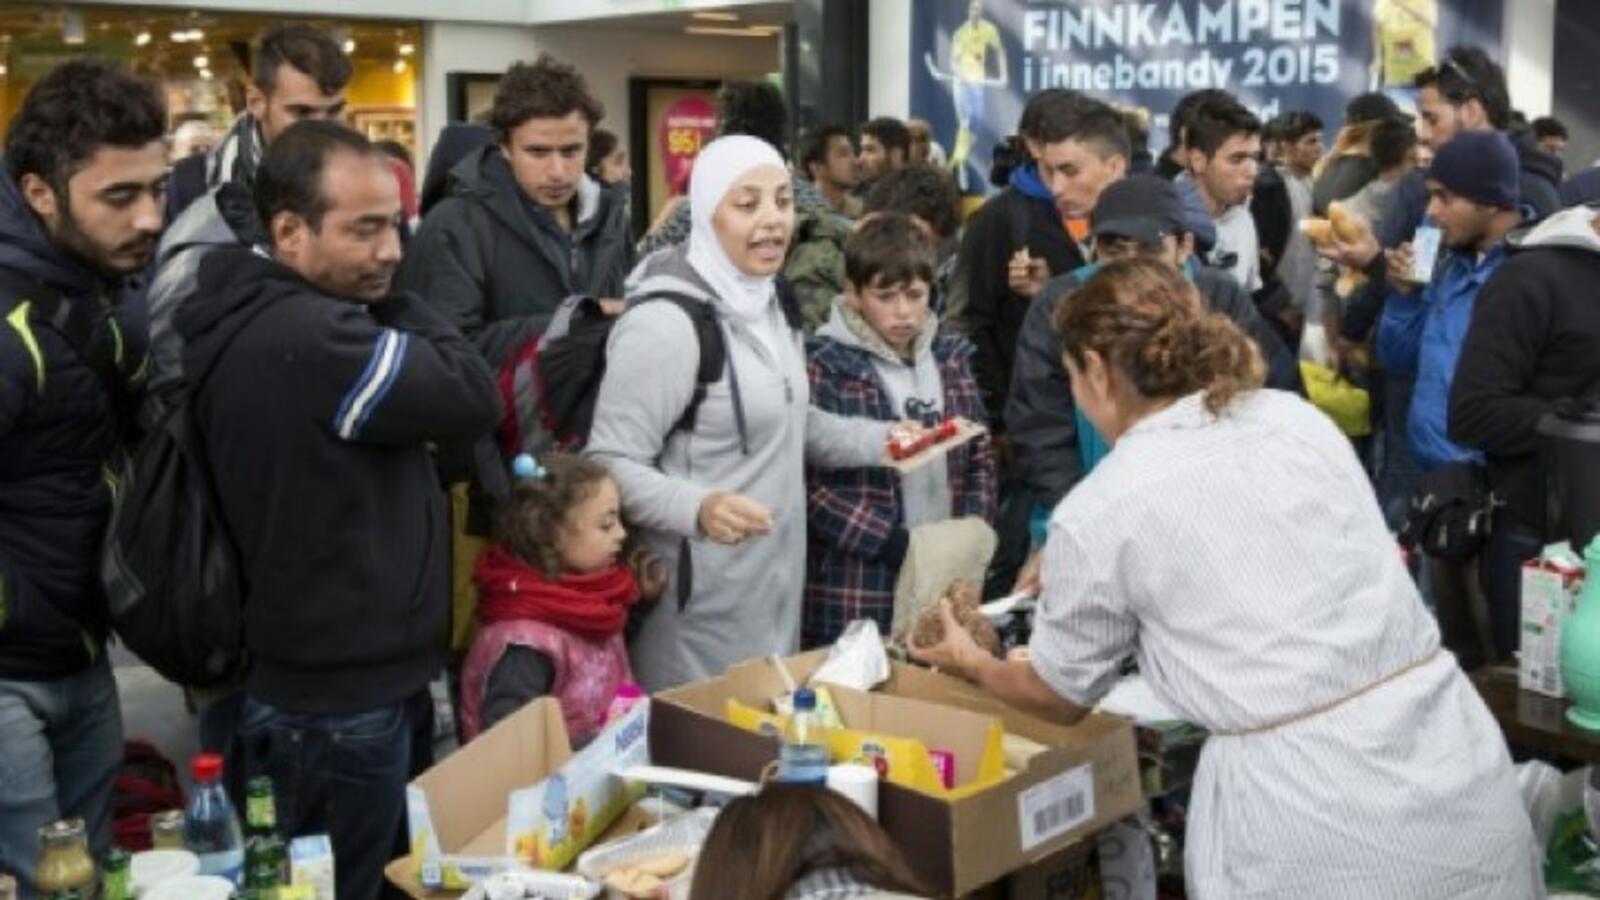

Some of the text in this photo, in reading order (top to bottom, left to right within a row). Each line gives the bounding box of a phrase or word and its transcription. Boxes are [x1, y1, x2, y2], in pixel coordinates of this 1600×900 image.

[1023, 0, 1341, 51] FINNKAMPEN
[1023, 44, 1340, 91] i innebandy 2015
